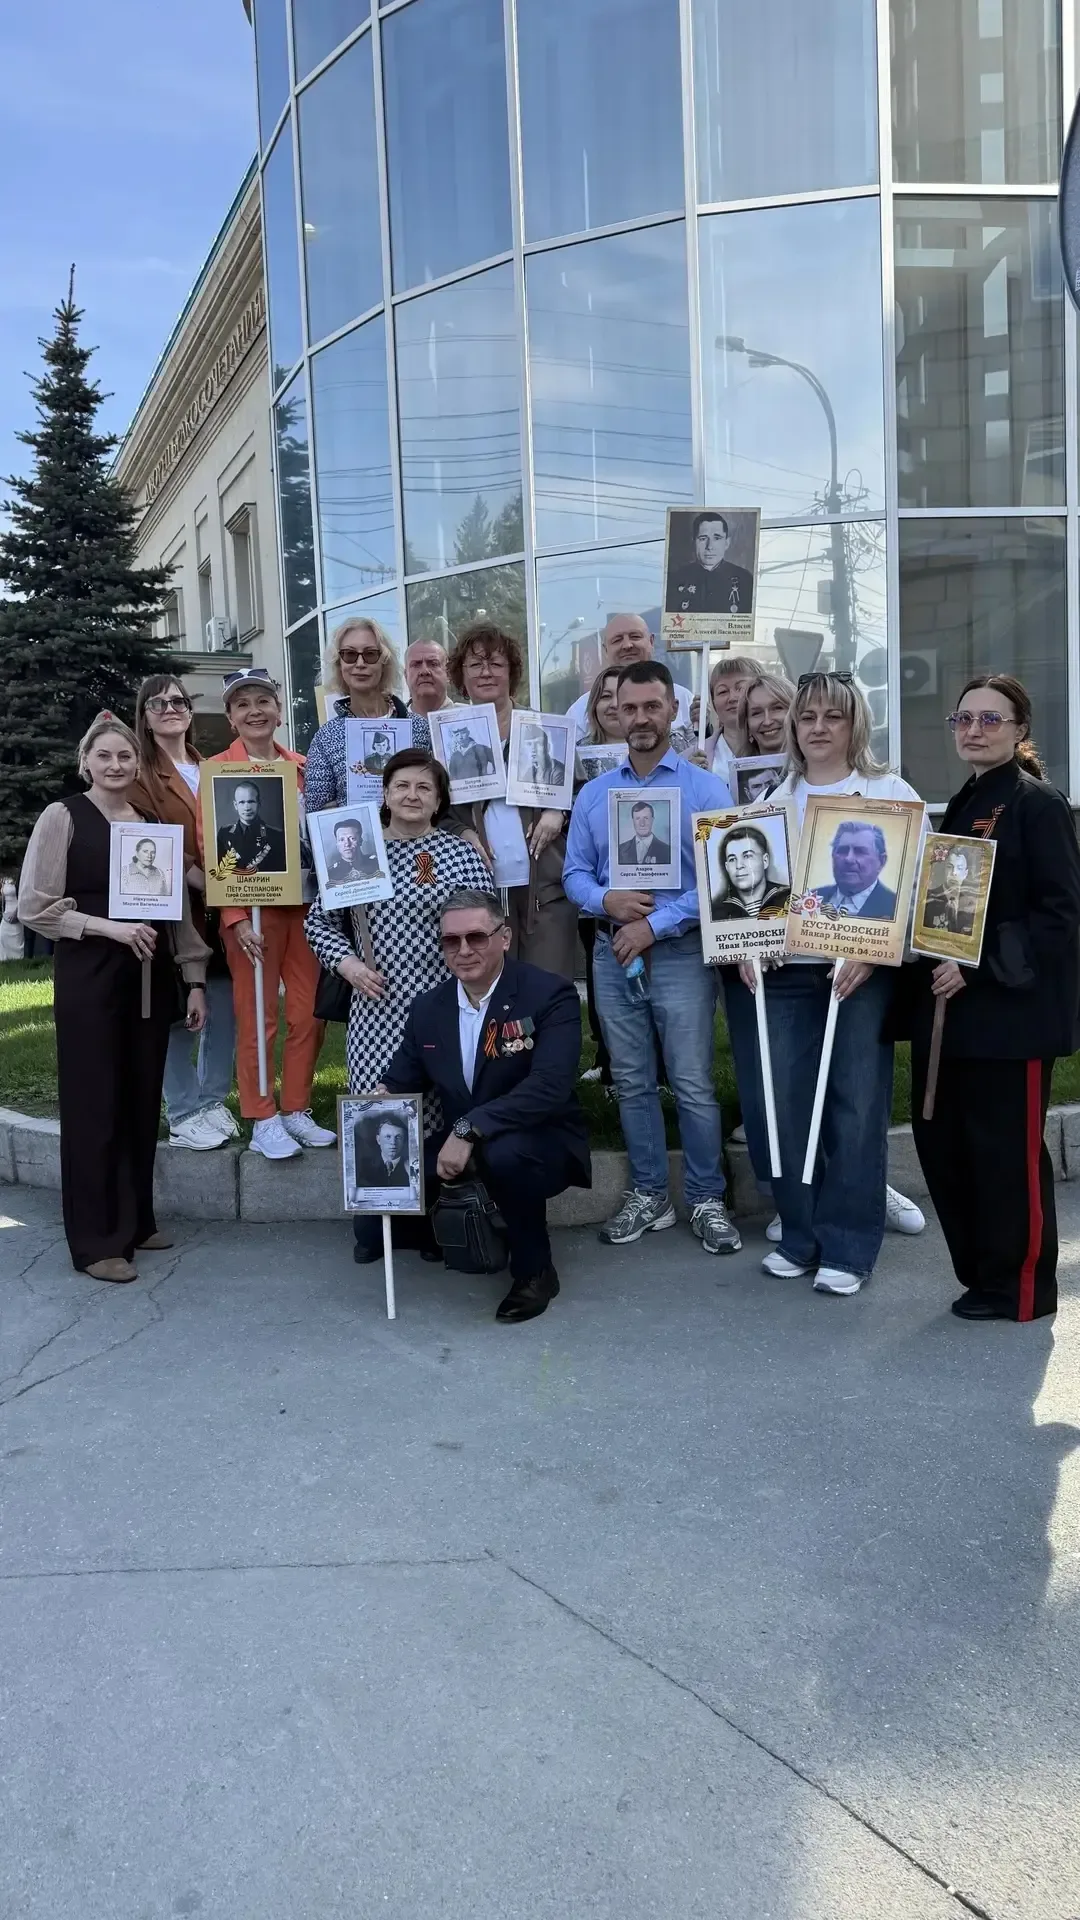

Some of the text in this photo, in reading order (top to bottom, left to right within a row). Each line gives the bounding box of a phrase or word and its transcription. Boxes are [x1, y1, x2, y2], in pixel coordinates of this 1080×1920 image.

[715, 928, 786, 942] КУСТАРОВСКИ
[802, 919, 891, 938] КУСТАРОВСКИЙ
[718, 938, 784, 950] Иван Иосифов
[800, 928, 890, 947] Макар Иосифович
